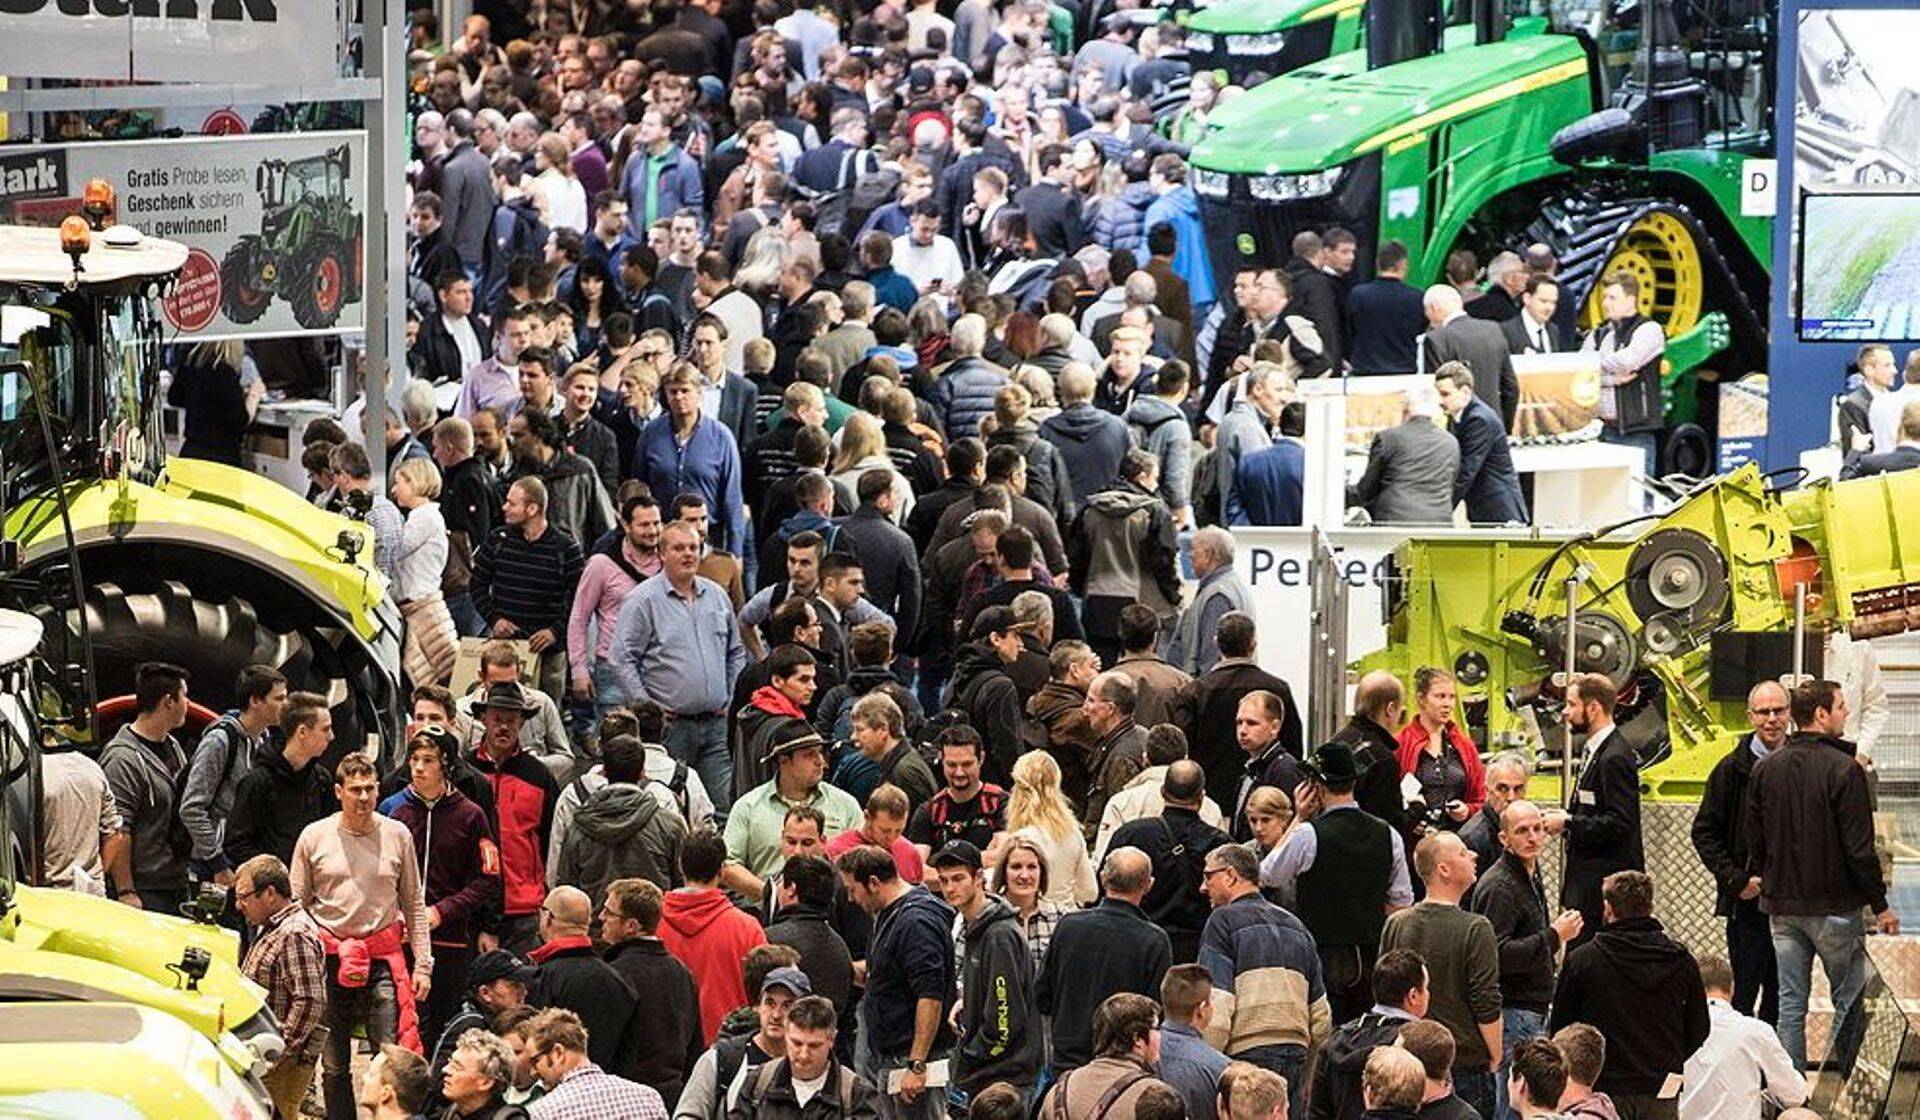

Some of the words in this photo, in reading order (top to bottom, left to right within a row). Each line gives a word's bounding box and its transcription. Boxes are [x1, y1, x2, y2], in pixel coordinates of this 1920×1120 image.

[127, 168, 168, 188] Gratis
[173, 166, 209, 185] Probe
[213, 165, 248, 184] lesen,
[1751, 172, 1768, 192] D
[127, 192, 195, 213] Geschenk
[199, 191, 244, 209] sichern
[155, 214, 227, 238] gewinnen!
